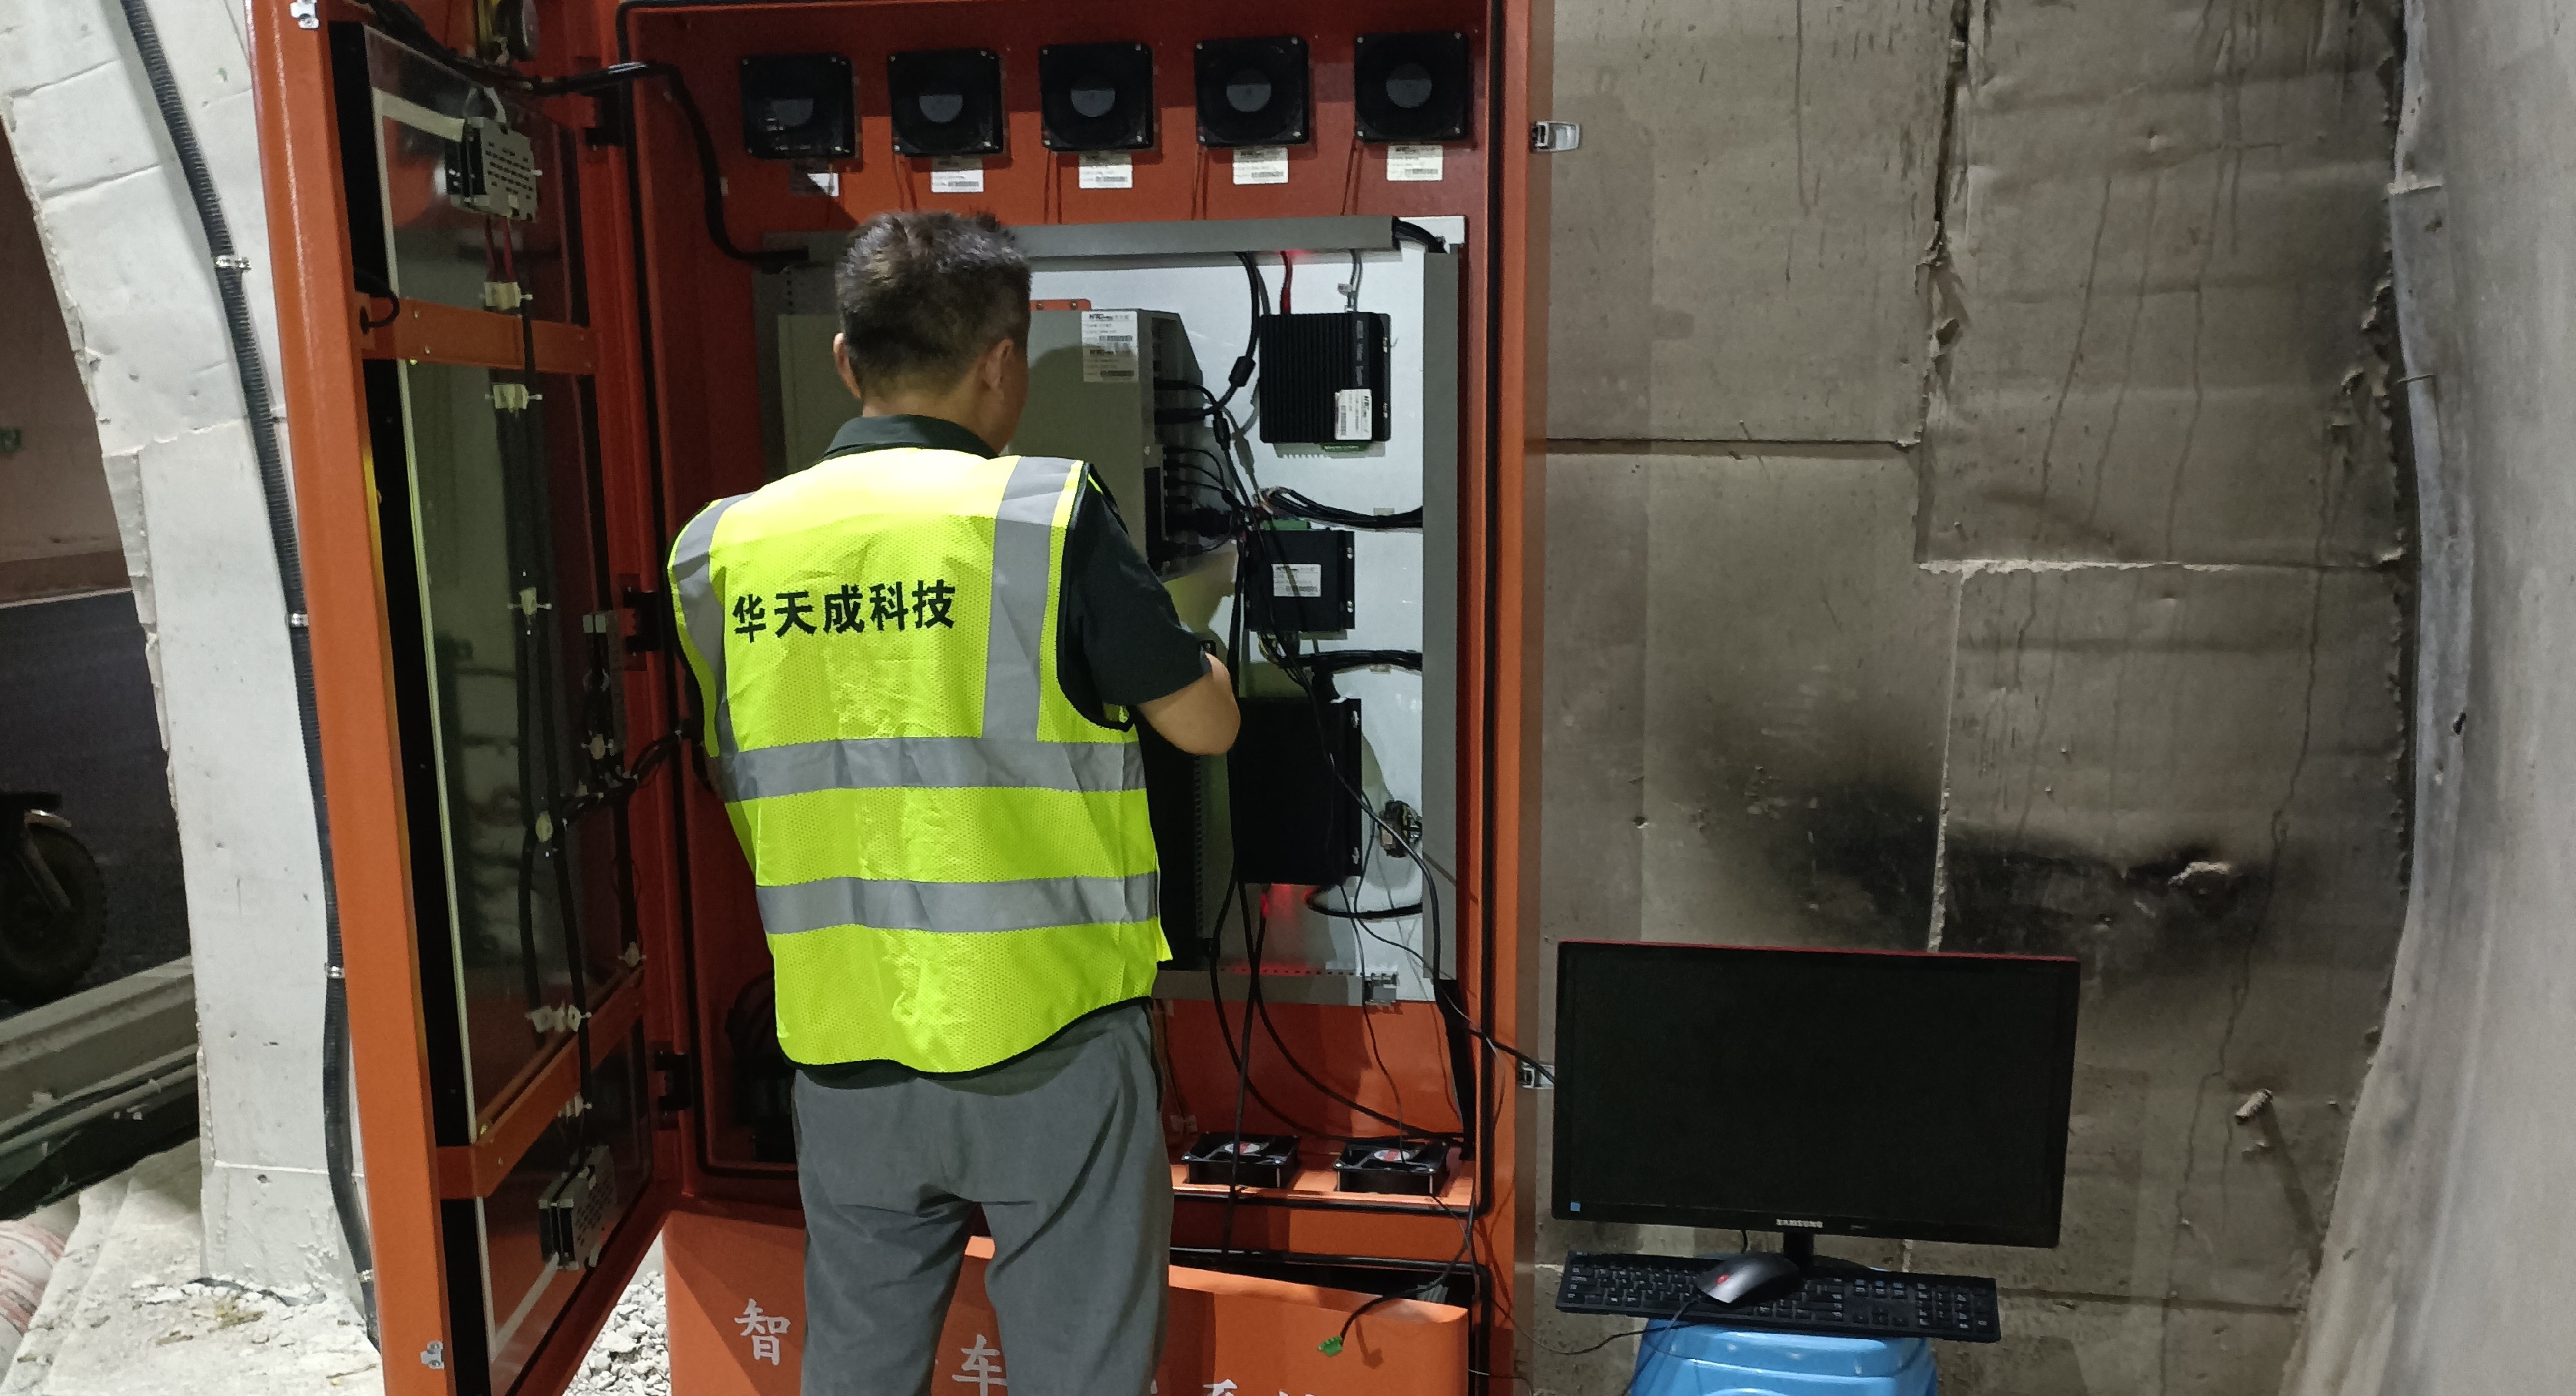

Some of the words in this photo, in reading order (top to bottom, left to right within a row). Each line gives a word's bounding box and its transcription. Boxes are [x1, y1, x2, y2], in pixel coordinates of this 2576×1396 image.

[732, 579, 956, 643] 华天成科技
